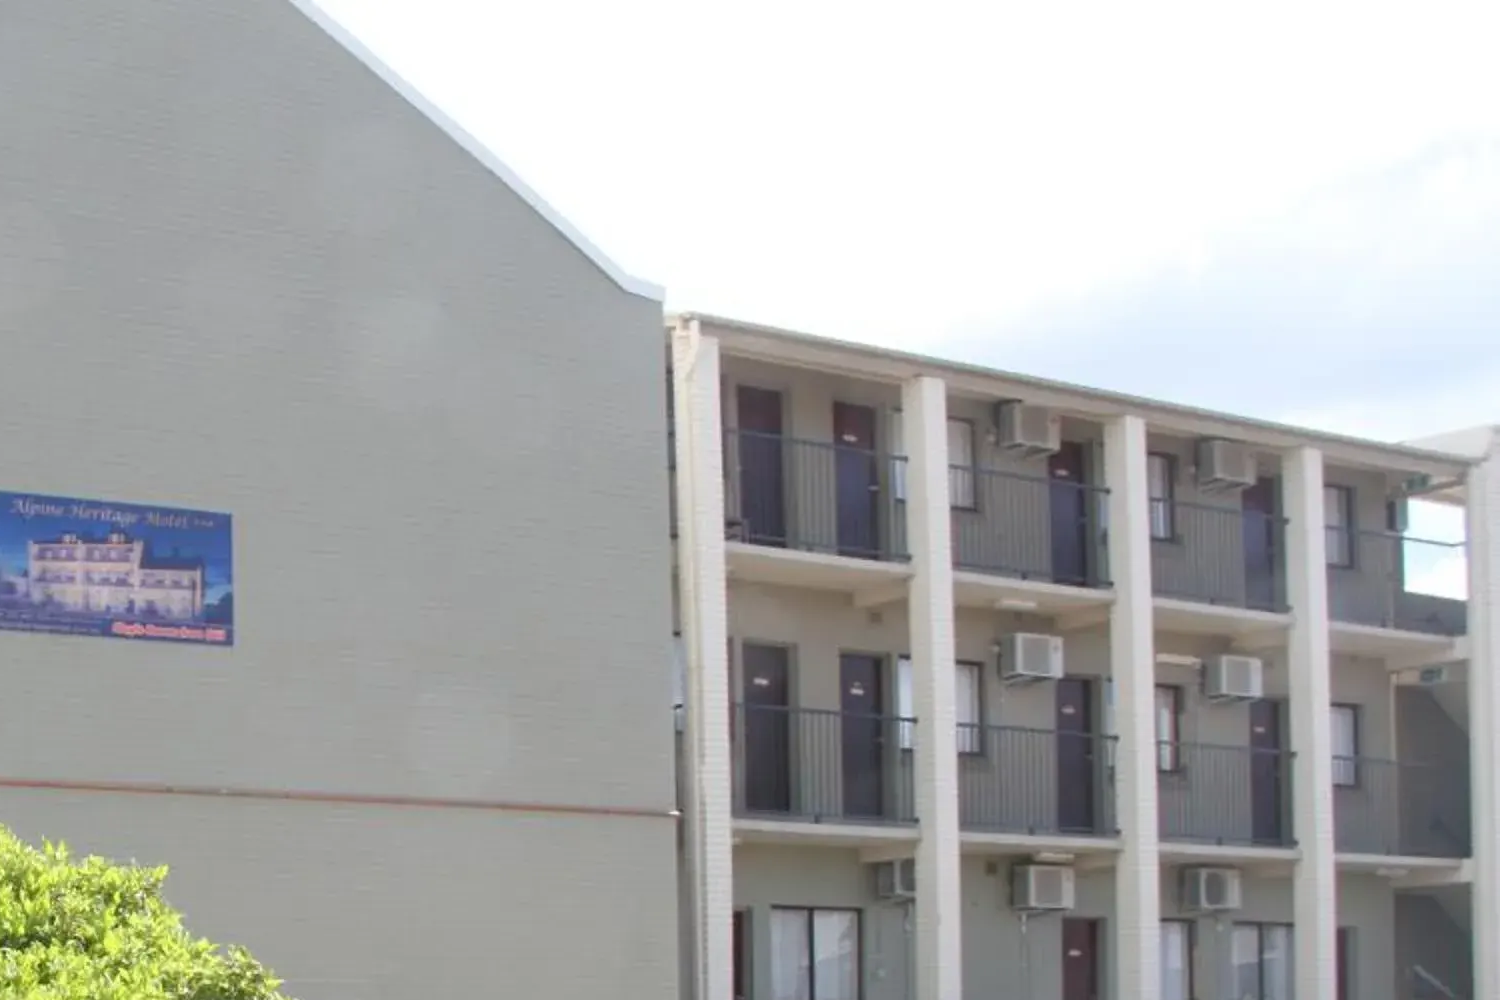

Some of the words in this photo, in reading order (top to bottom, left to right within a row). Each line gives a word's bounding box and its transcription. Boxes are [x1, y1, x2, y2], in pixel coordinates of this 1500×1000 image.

[10, 500, 64, 519] Alpine
[70, 505, 138, 527] Heritage
[145, 510, 189, 528] Motel
